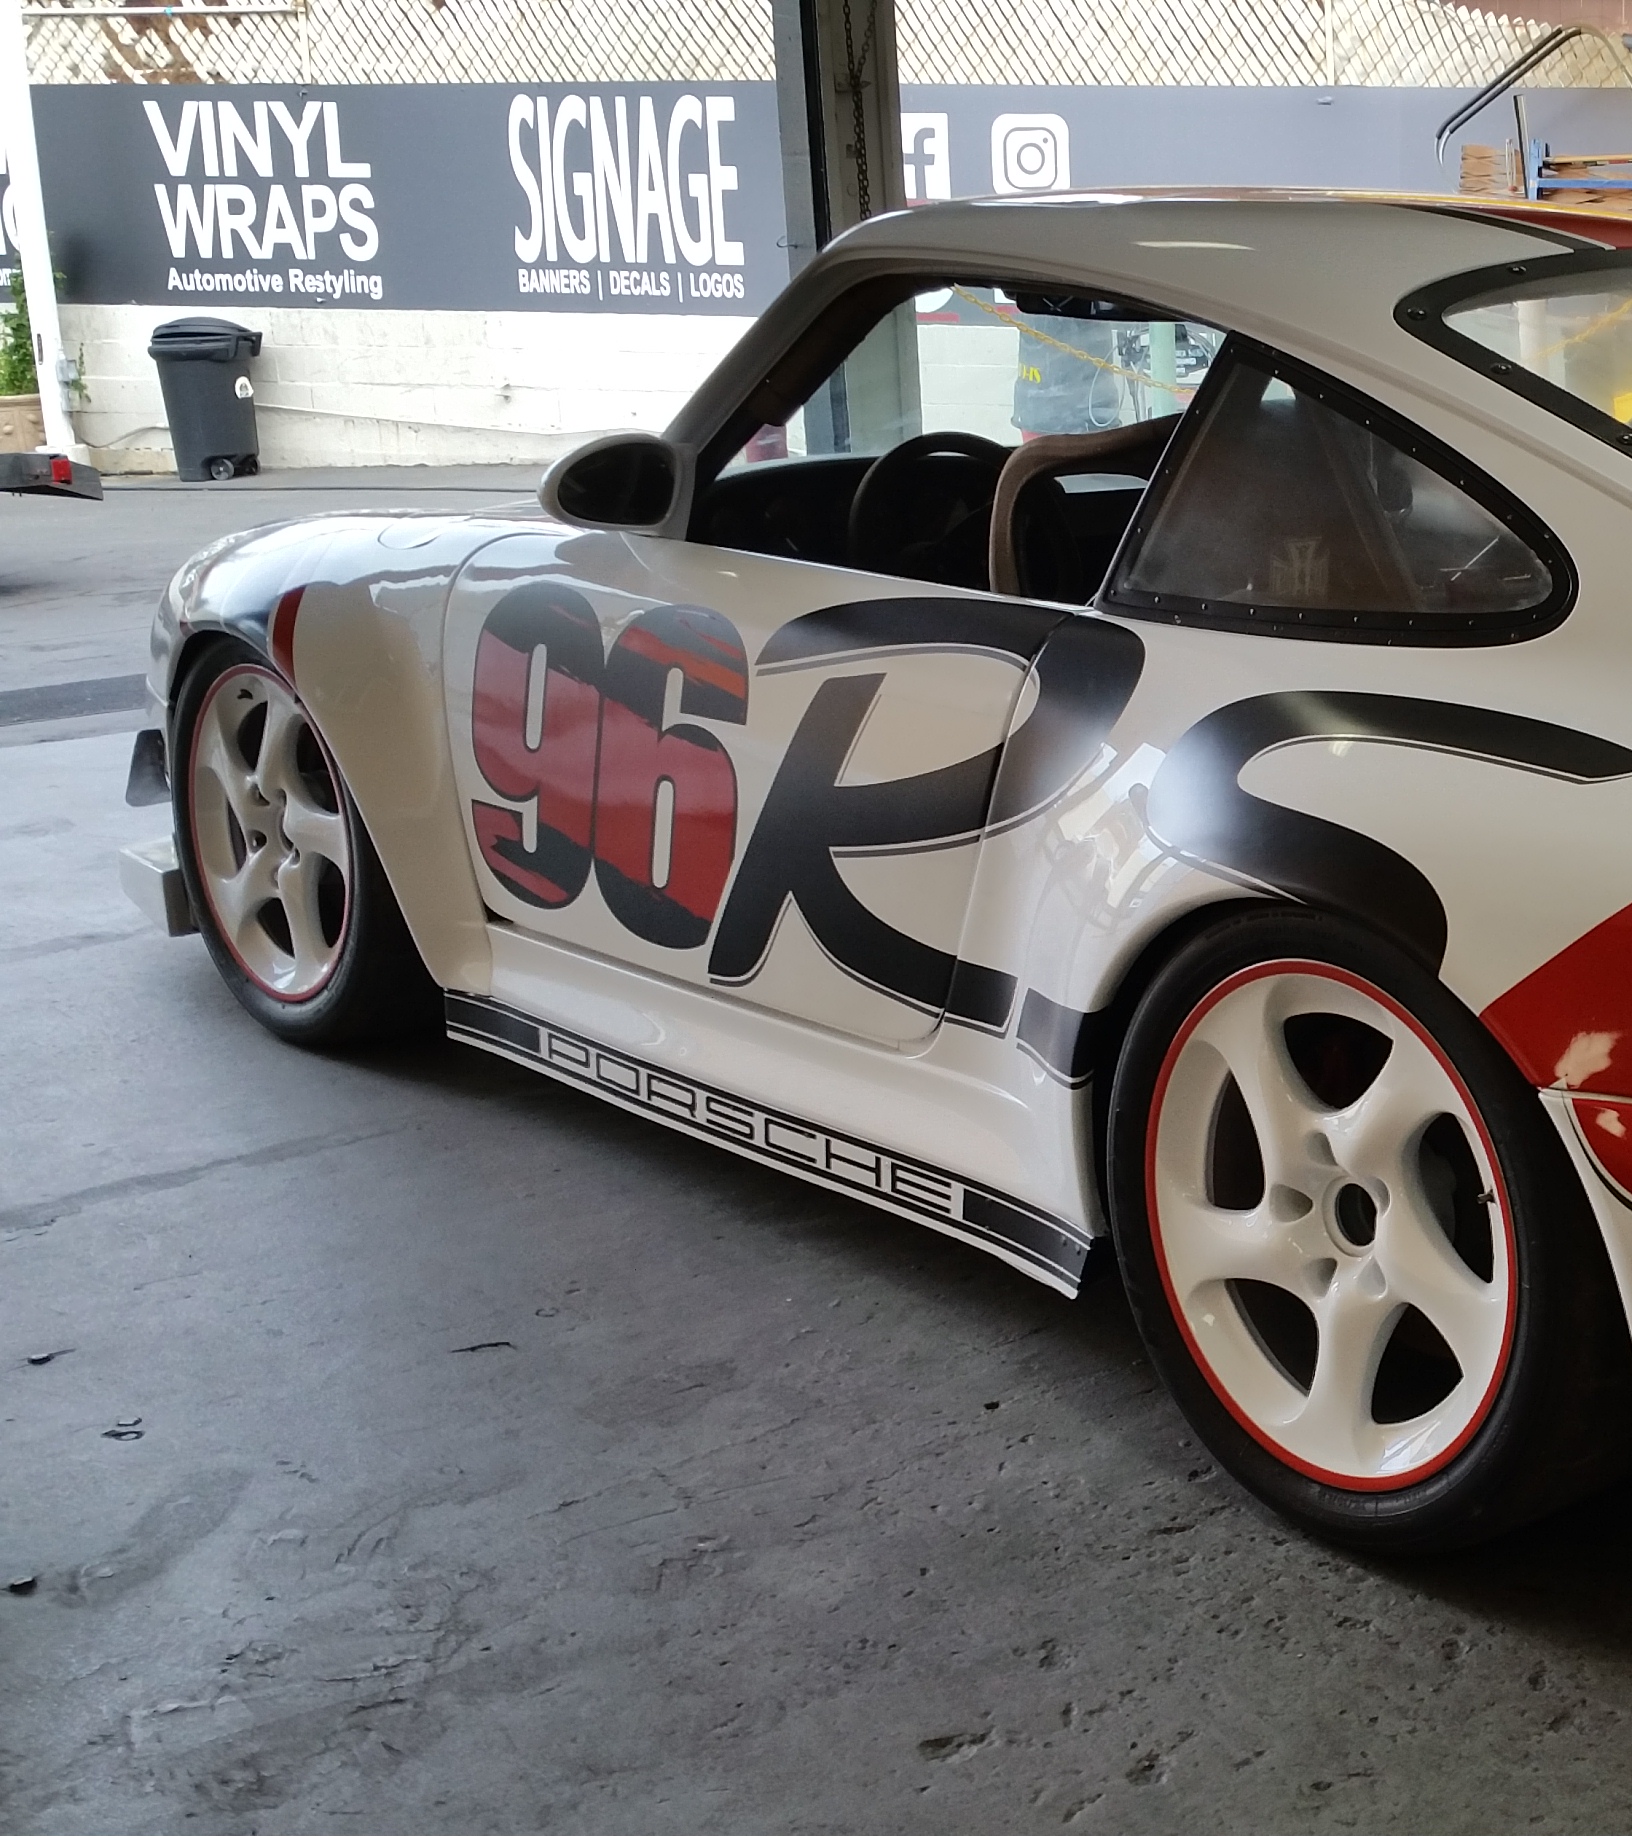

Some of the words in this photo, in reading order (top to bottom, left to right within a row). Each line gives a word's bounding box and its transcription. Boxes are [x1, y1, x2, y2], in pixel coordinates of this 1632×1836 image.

[142, 100, 372, 178] VINYL
[508, 93, 745, 267] SIGNAGE
[153, 183, 379, 262] WRAPS
[167, 267, 284, 292] Automotive
[288, 268, 384, 300] Restyling
[517, 268, 591, 294] BANNERS
[609, 271, 671, 296] DECALS
[689, 272, 745, 299] LOGOS
[547, 1031, 954, 1217] PORSCHE
